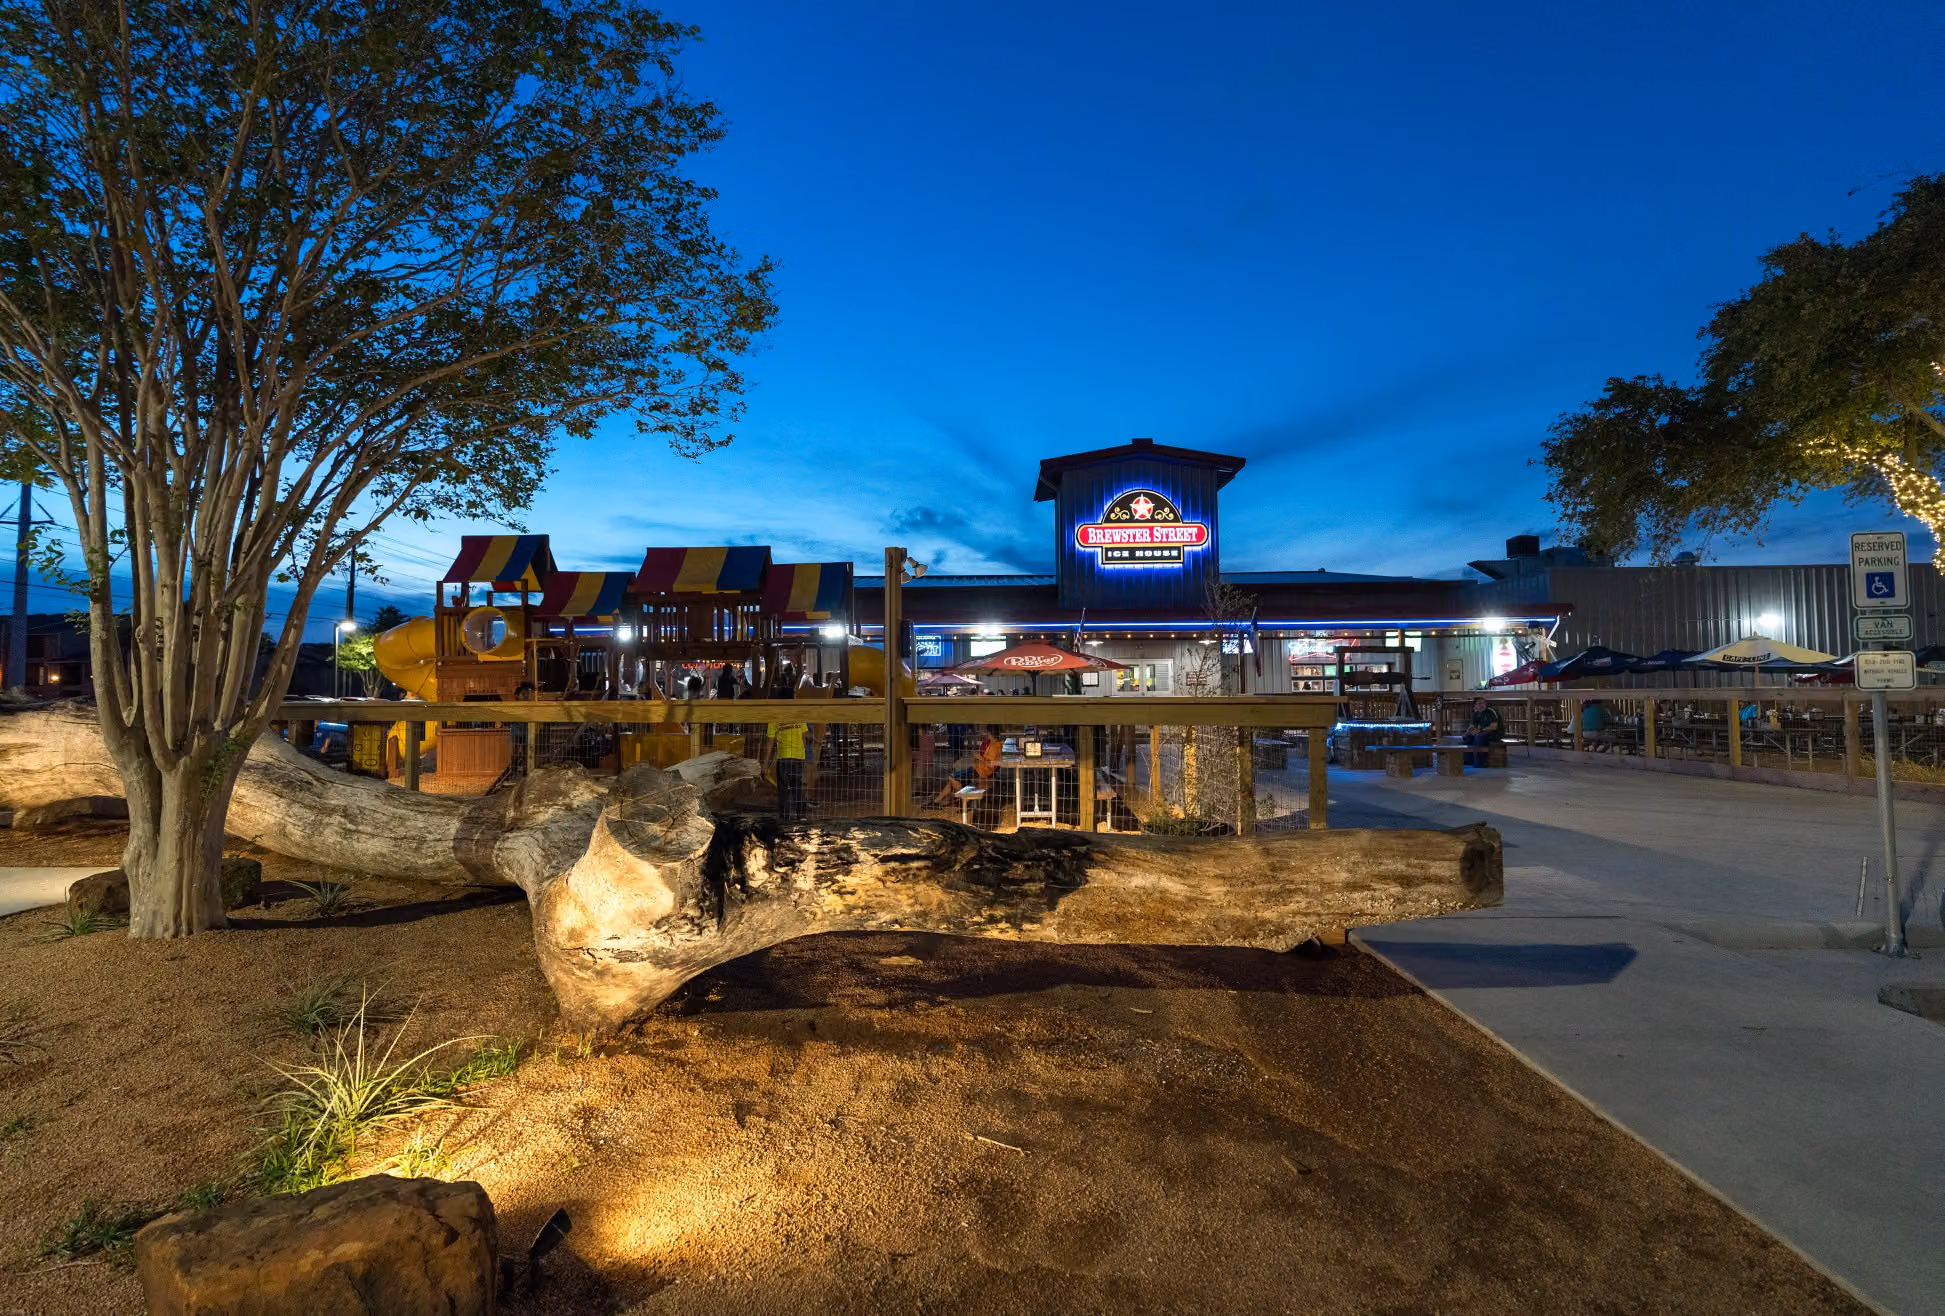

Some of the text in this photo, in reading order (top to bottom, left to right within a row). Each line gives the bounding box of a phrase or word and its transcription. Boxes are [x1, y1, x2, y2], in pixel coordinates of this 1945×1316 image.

[1087, 527, 1198, 543] BREWSTER STREET
[1854, 541, 1902, 552] RESERVED
[1858, 556, 1900, 567] PARKING
[1874, 619, 1893, 628] VAN
